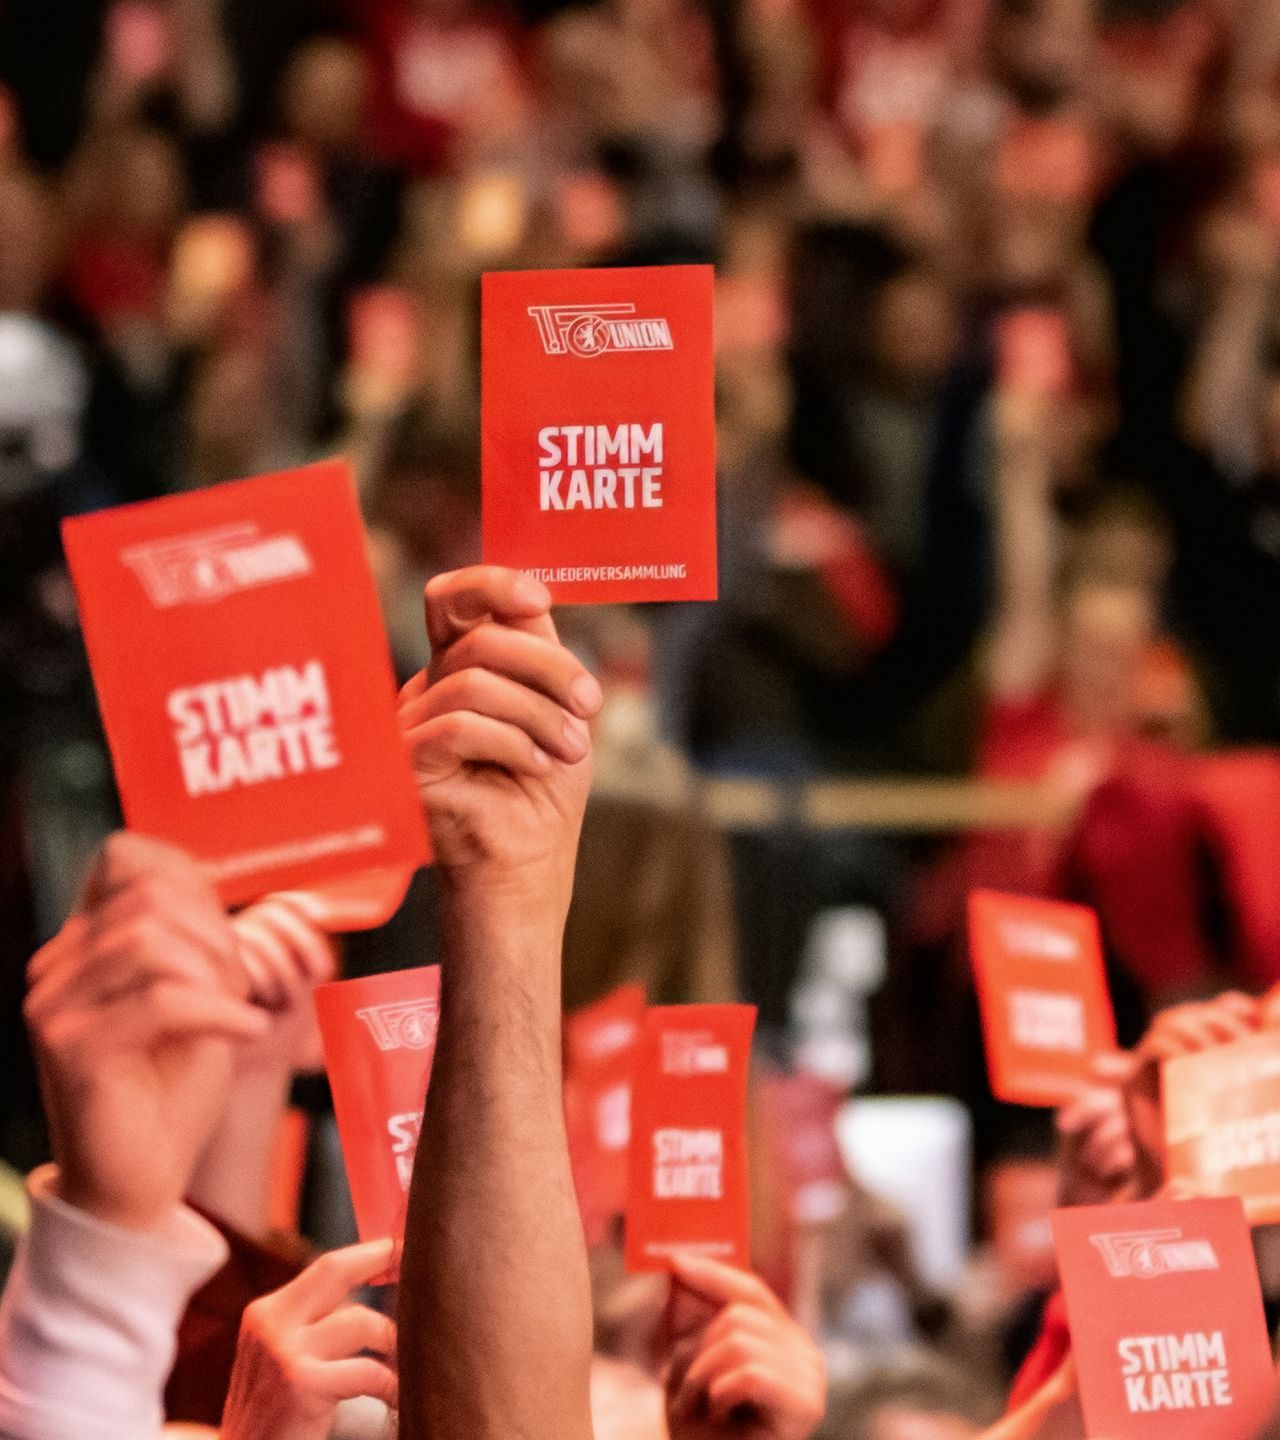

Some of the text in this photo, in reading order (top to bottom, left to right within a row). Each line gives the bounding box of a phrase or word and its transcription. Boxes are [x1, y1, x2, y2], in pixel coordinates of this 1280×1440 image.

[609, 322, 670, 349] UNION
[537, 422, 663, 467] STIMM
[539, 467, 664, 511] KARTE
[167, 660, 329, 748] STIMM
[181, 717, 342, 797] KARTE
[1118, 1331, 1226, 1376] STIMM
[1124, 1368, 1233, 1414] KARTE
